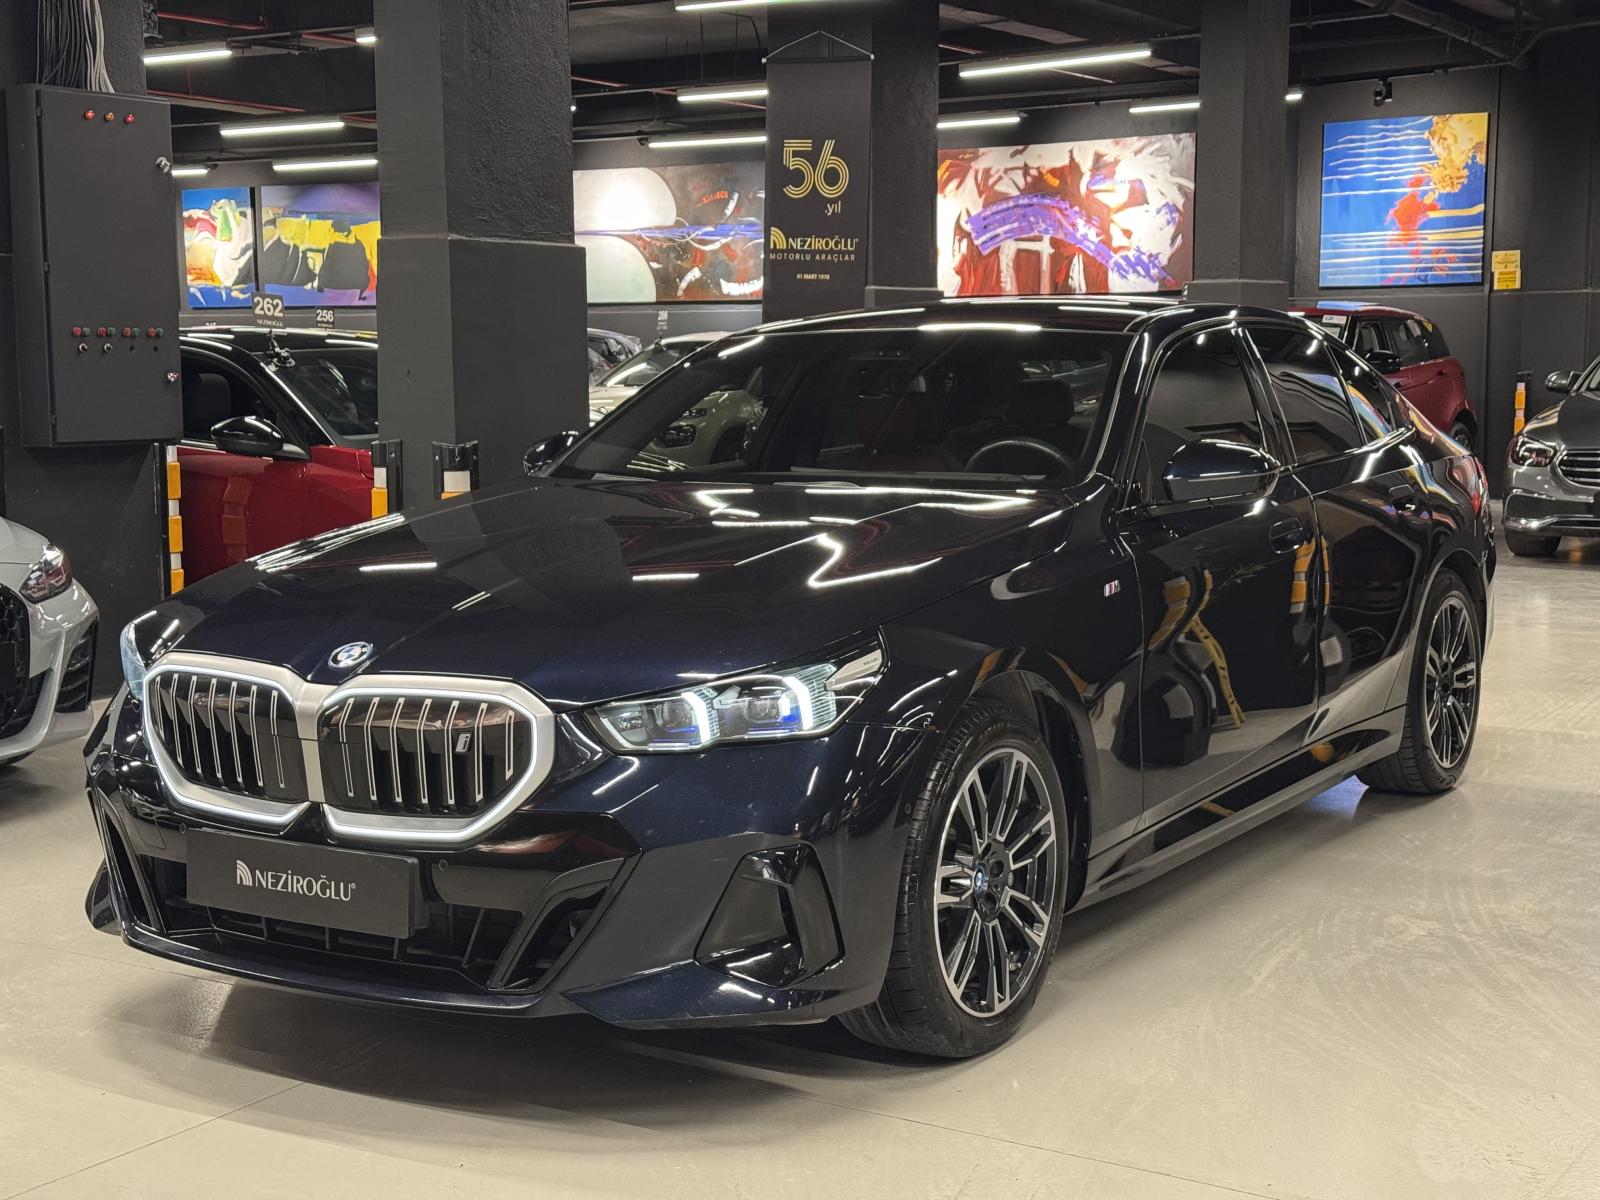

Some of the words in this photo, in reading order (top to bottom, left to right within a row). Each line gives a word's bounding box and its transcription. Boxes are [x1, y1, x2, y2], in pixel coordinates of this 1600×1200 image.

[783, 139, 849, 198] 56
[815, 253, 856, 263] ARAÇLAR
[253, 296, 284, 318] 262
[316, 309, 334, 323] 256
